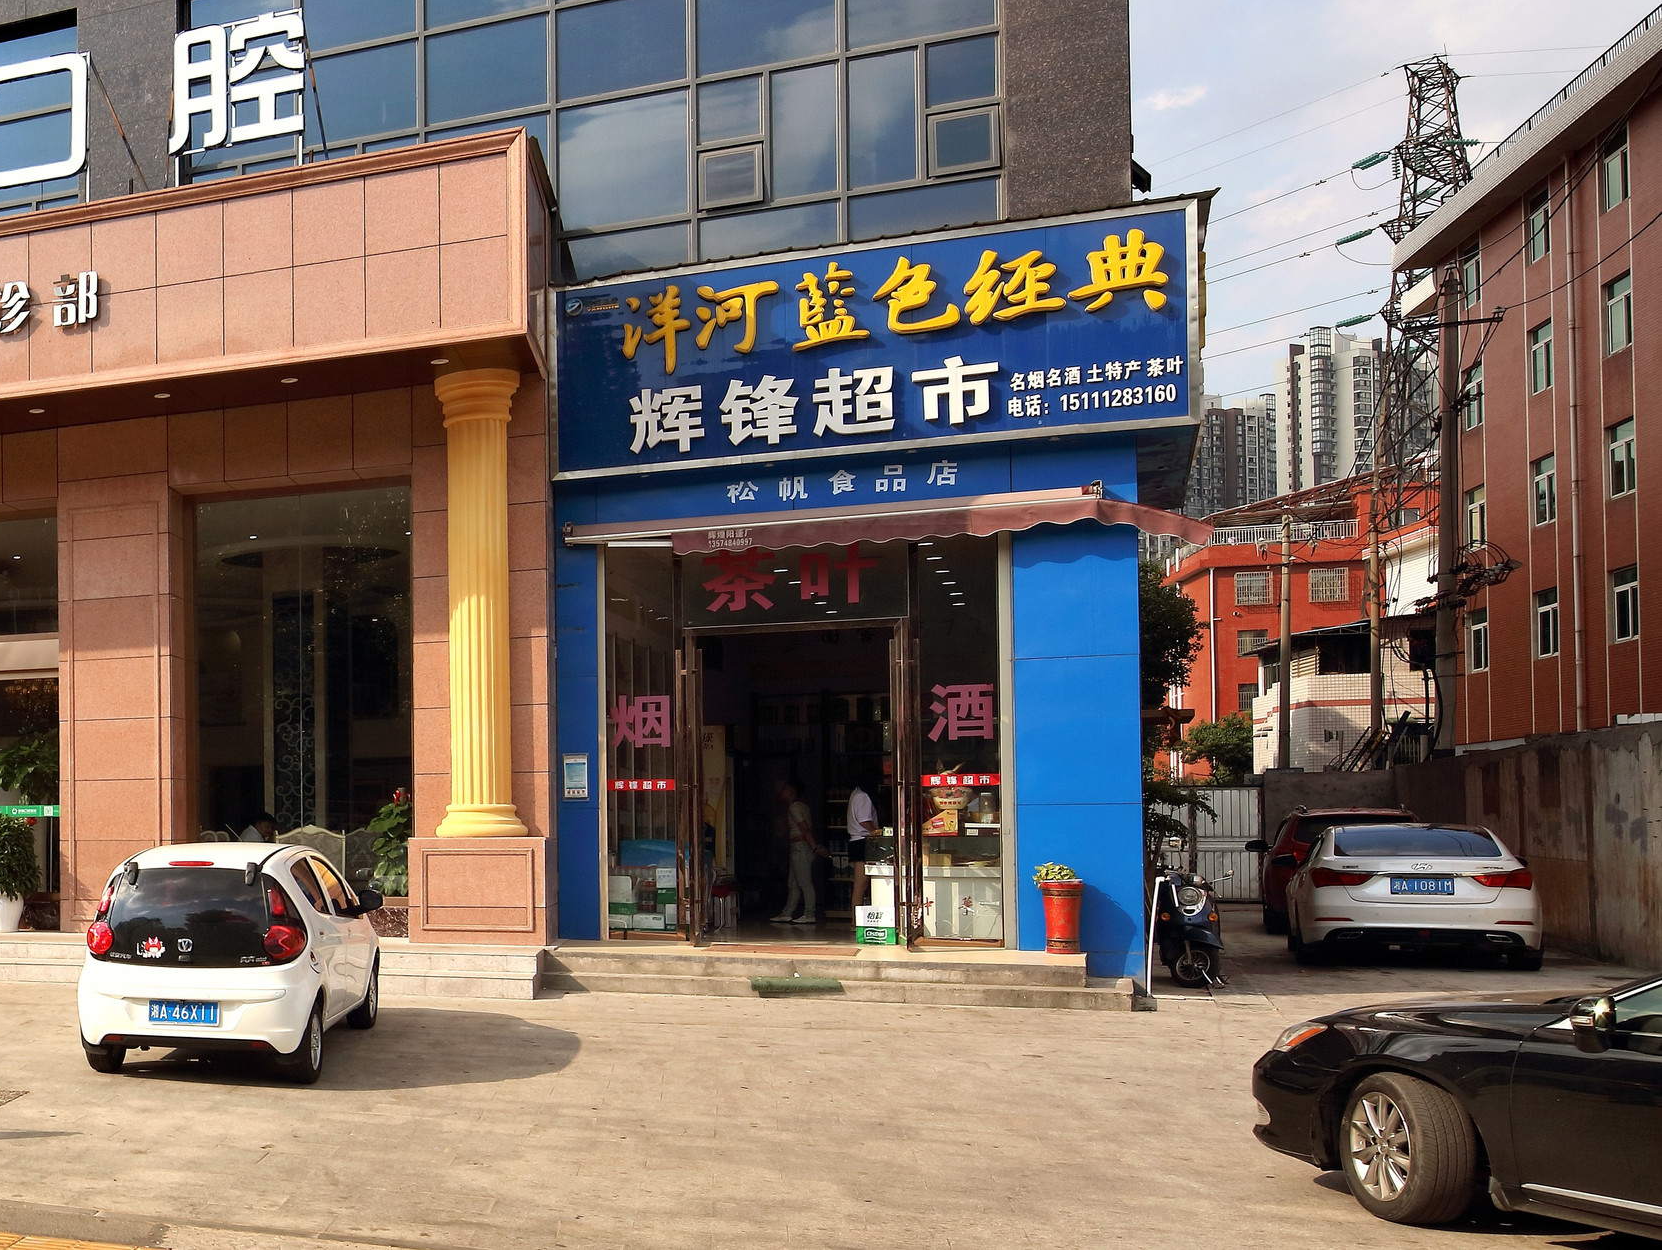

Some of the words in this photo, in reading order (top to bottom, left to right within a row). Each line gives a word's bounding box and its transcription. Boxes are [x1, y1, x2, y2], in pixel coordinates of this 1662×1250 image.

[1009, 365, 1081, 392] 名烟名酒
[1086, 360, 1142, 383] 土特产
[1146, 355, 1184, 378] 茶叶
[628, 355, 999, 455] 辉锋超市
[1059, 383, 1177, 412] 15111283160
[726, 459, 959, 504] 松帆食品店
[702, 542, 878, 613] 茶叶
[610, 695, 671, 749] 烟
[927, 683, 994, 742] 酒
[614, 780, 667, 790] 辉锋超市
[930, 775, 991, 786] 辉锋超市
